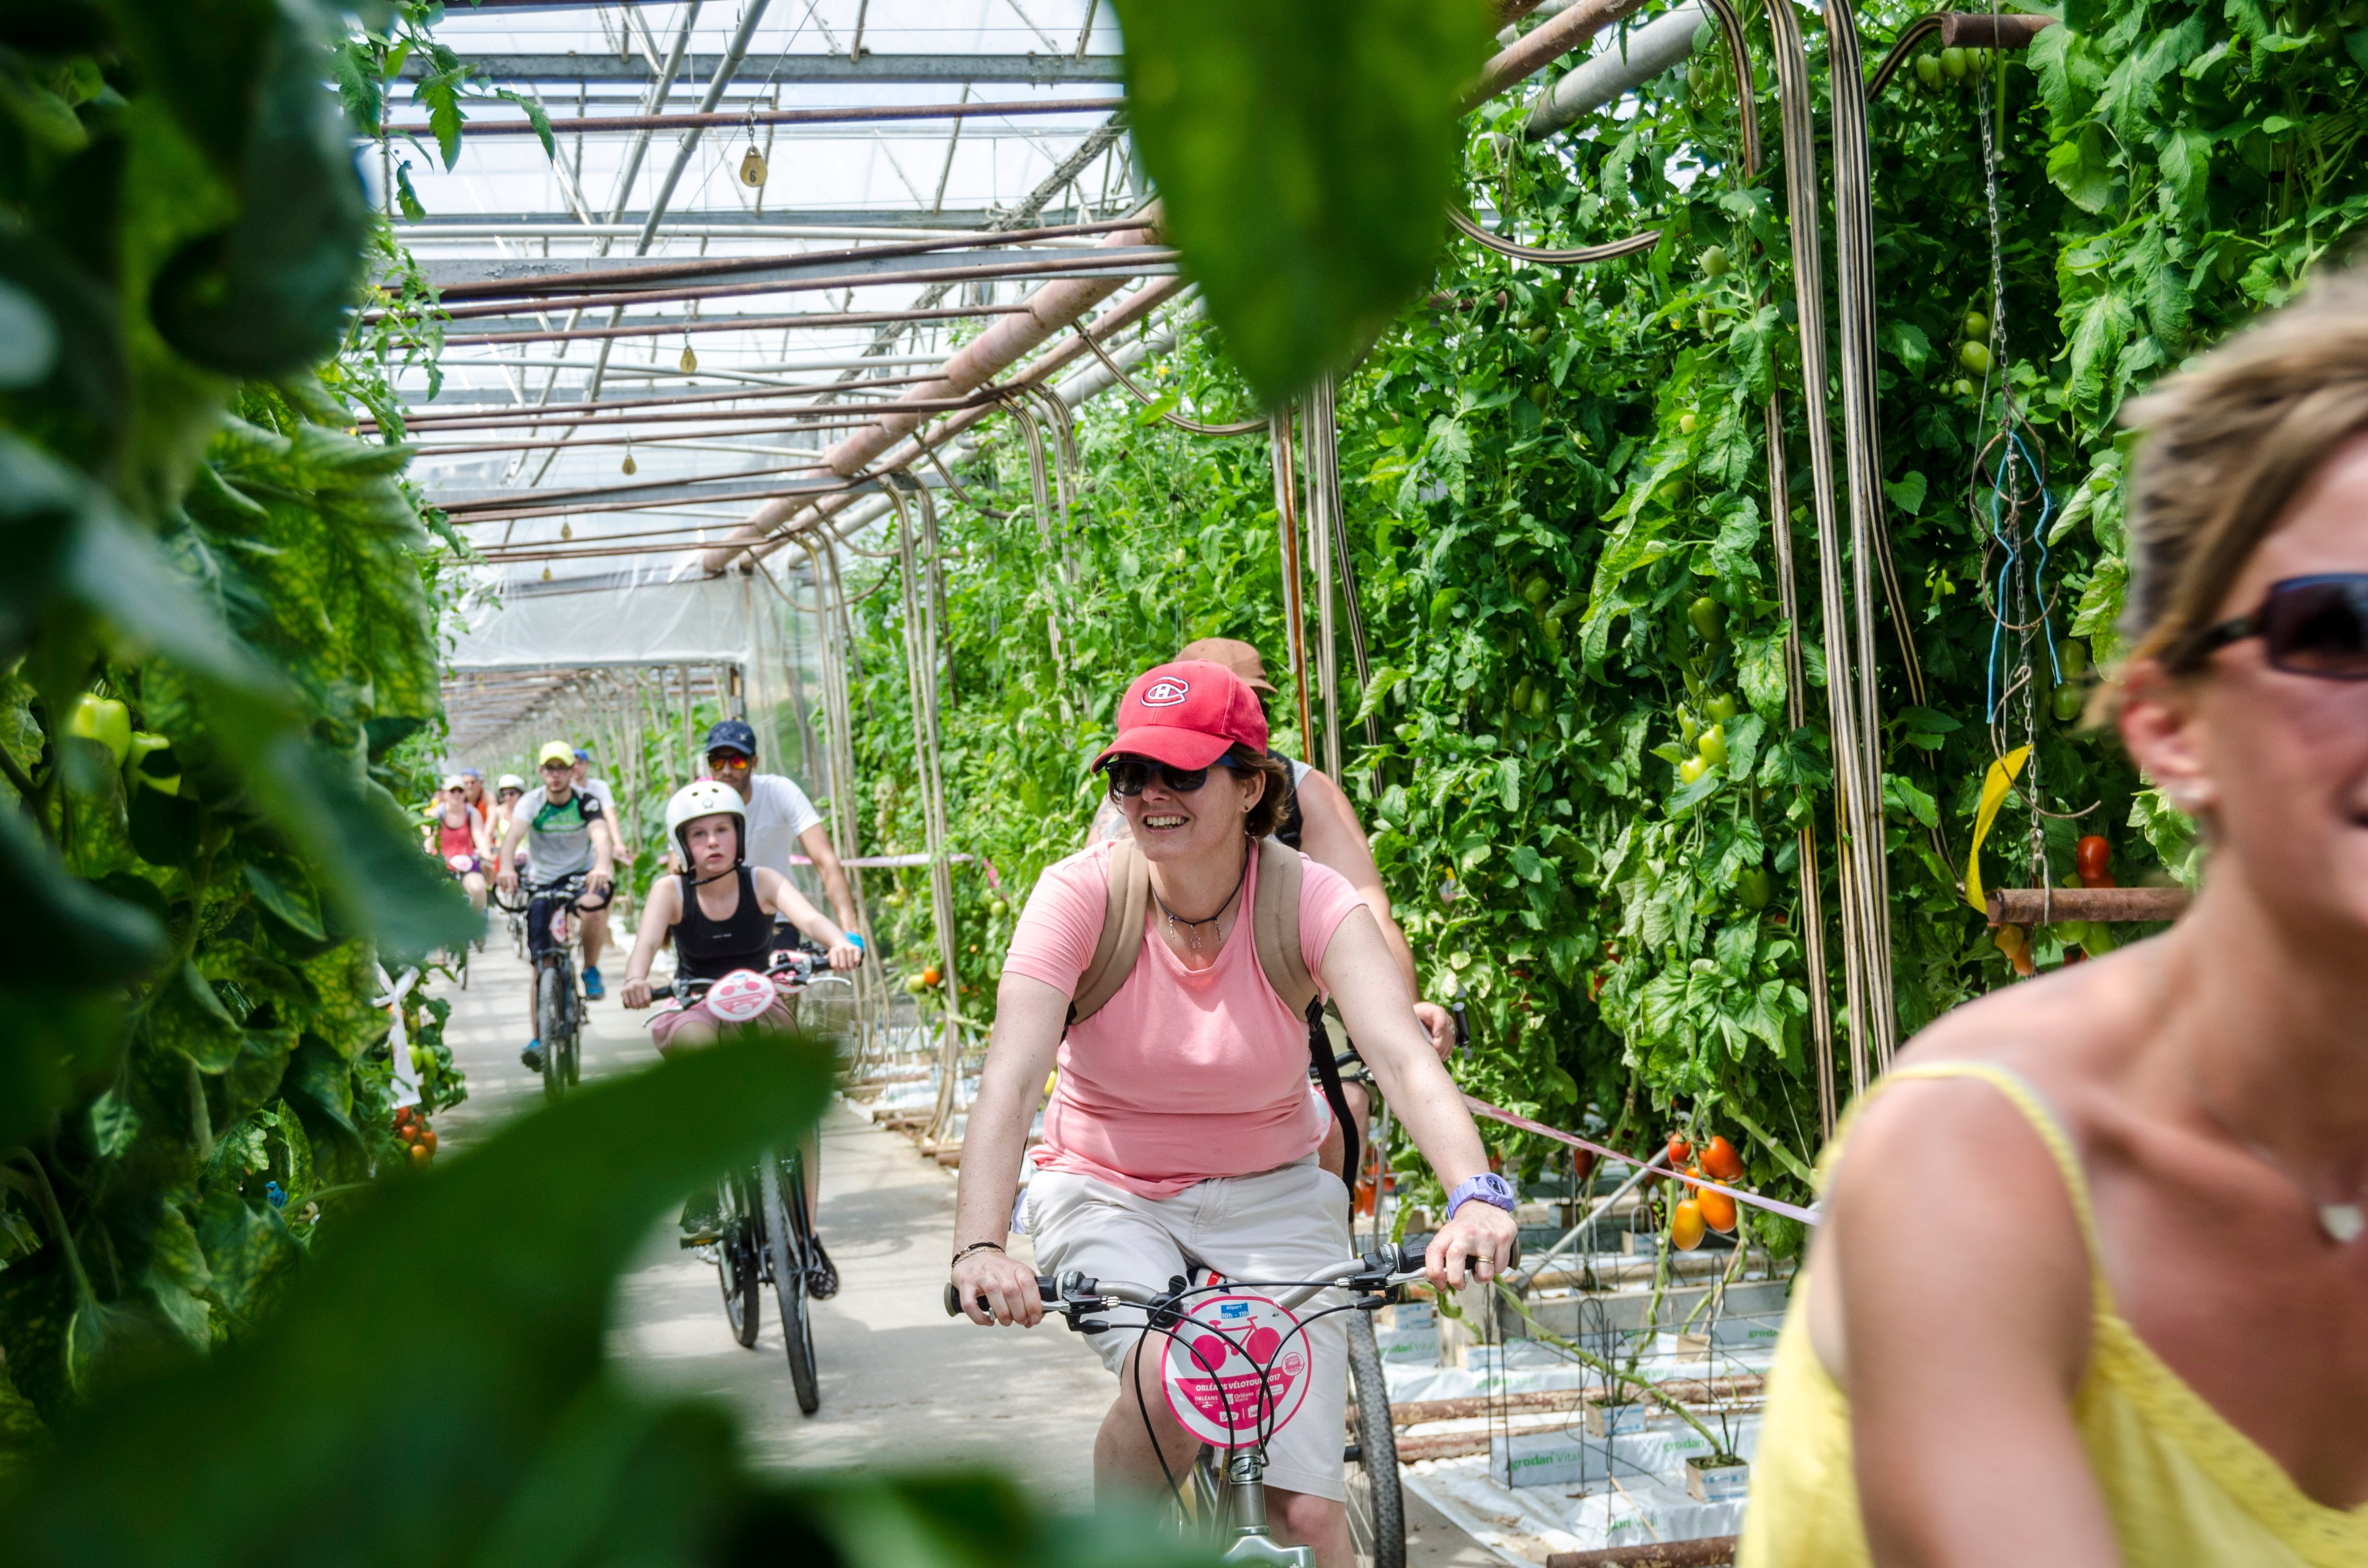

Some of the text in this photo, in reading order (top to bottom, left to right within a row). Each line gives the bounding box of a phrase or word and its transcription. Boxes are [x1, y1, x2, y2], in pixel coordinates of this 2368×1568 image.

[750, 169, 756, 183] 6
[1663, 1438, 1705, 1453] grodan
[1511, 1454, 1553, 1471] grodan
[1556, 1450, 1581, 1463] Vital
